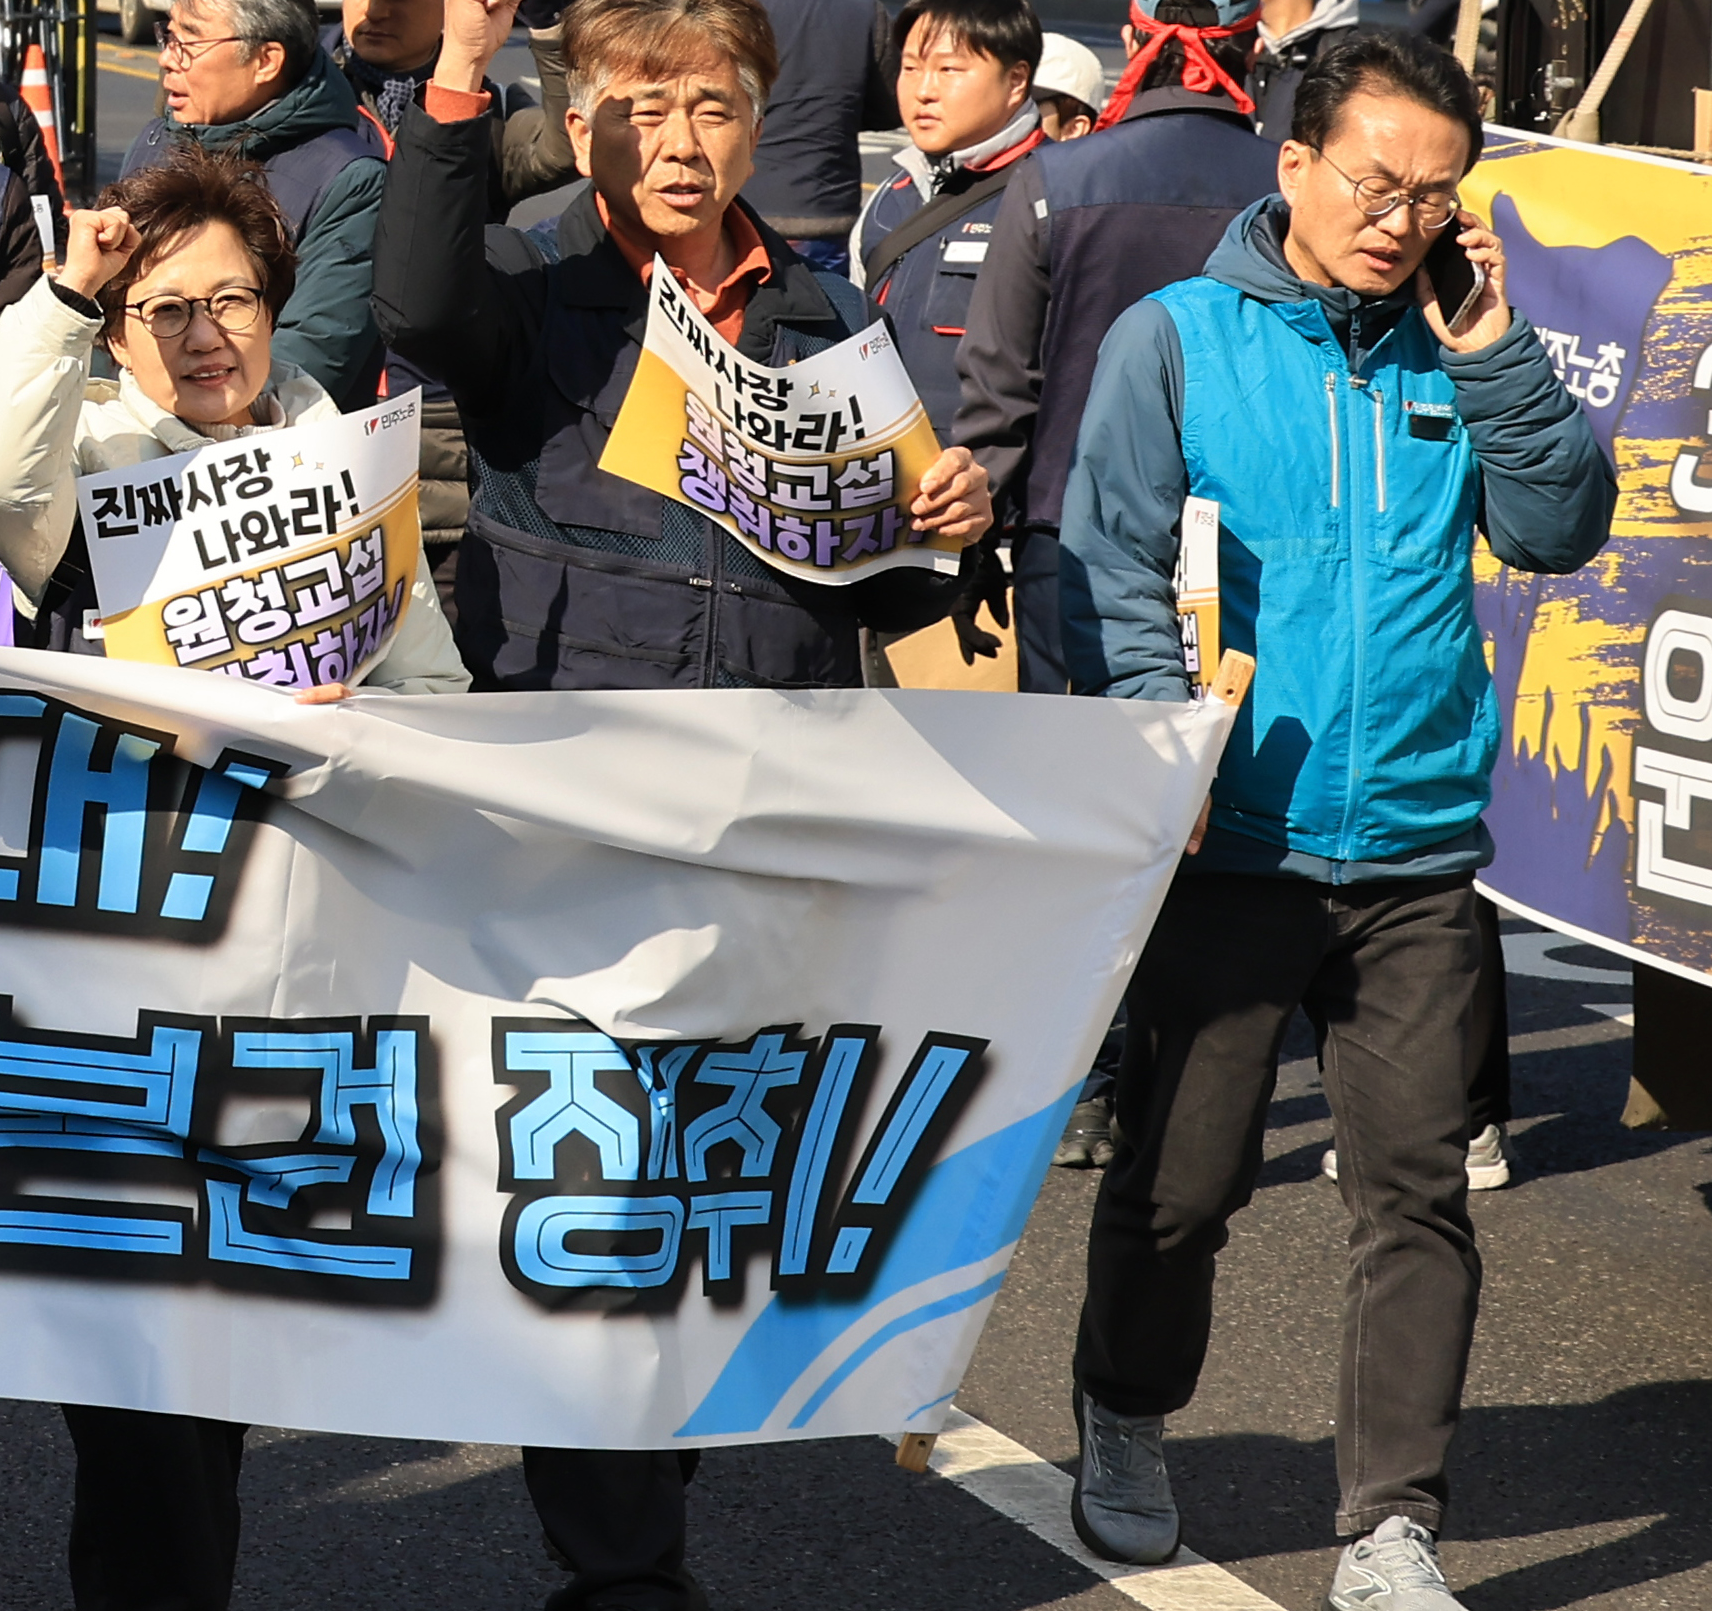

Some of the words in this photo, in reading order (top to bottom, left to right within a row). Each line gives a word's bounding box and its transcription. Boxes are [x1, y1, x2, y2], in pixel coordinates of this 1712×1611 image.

[1533, 326, 1627, 408] 주노총
[380, 401, 417, 434] 민주노총
[686, 393, 895, 510] 원청교섭
[716, 381, 866, 454] 나와라!
[91, 450, 273, 539] 진짜사장
[194, 469, 362, 571] 나와라!
[159, 525, 386, 667] 원청교섭
